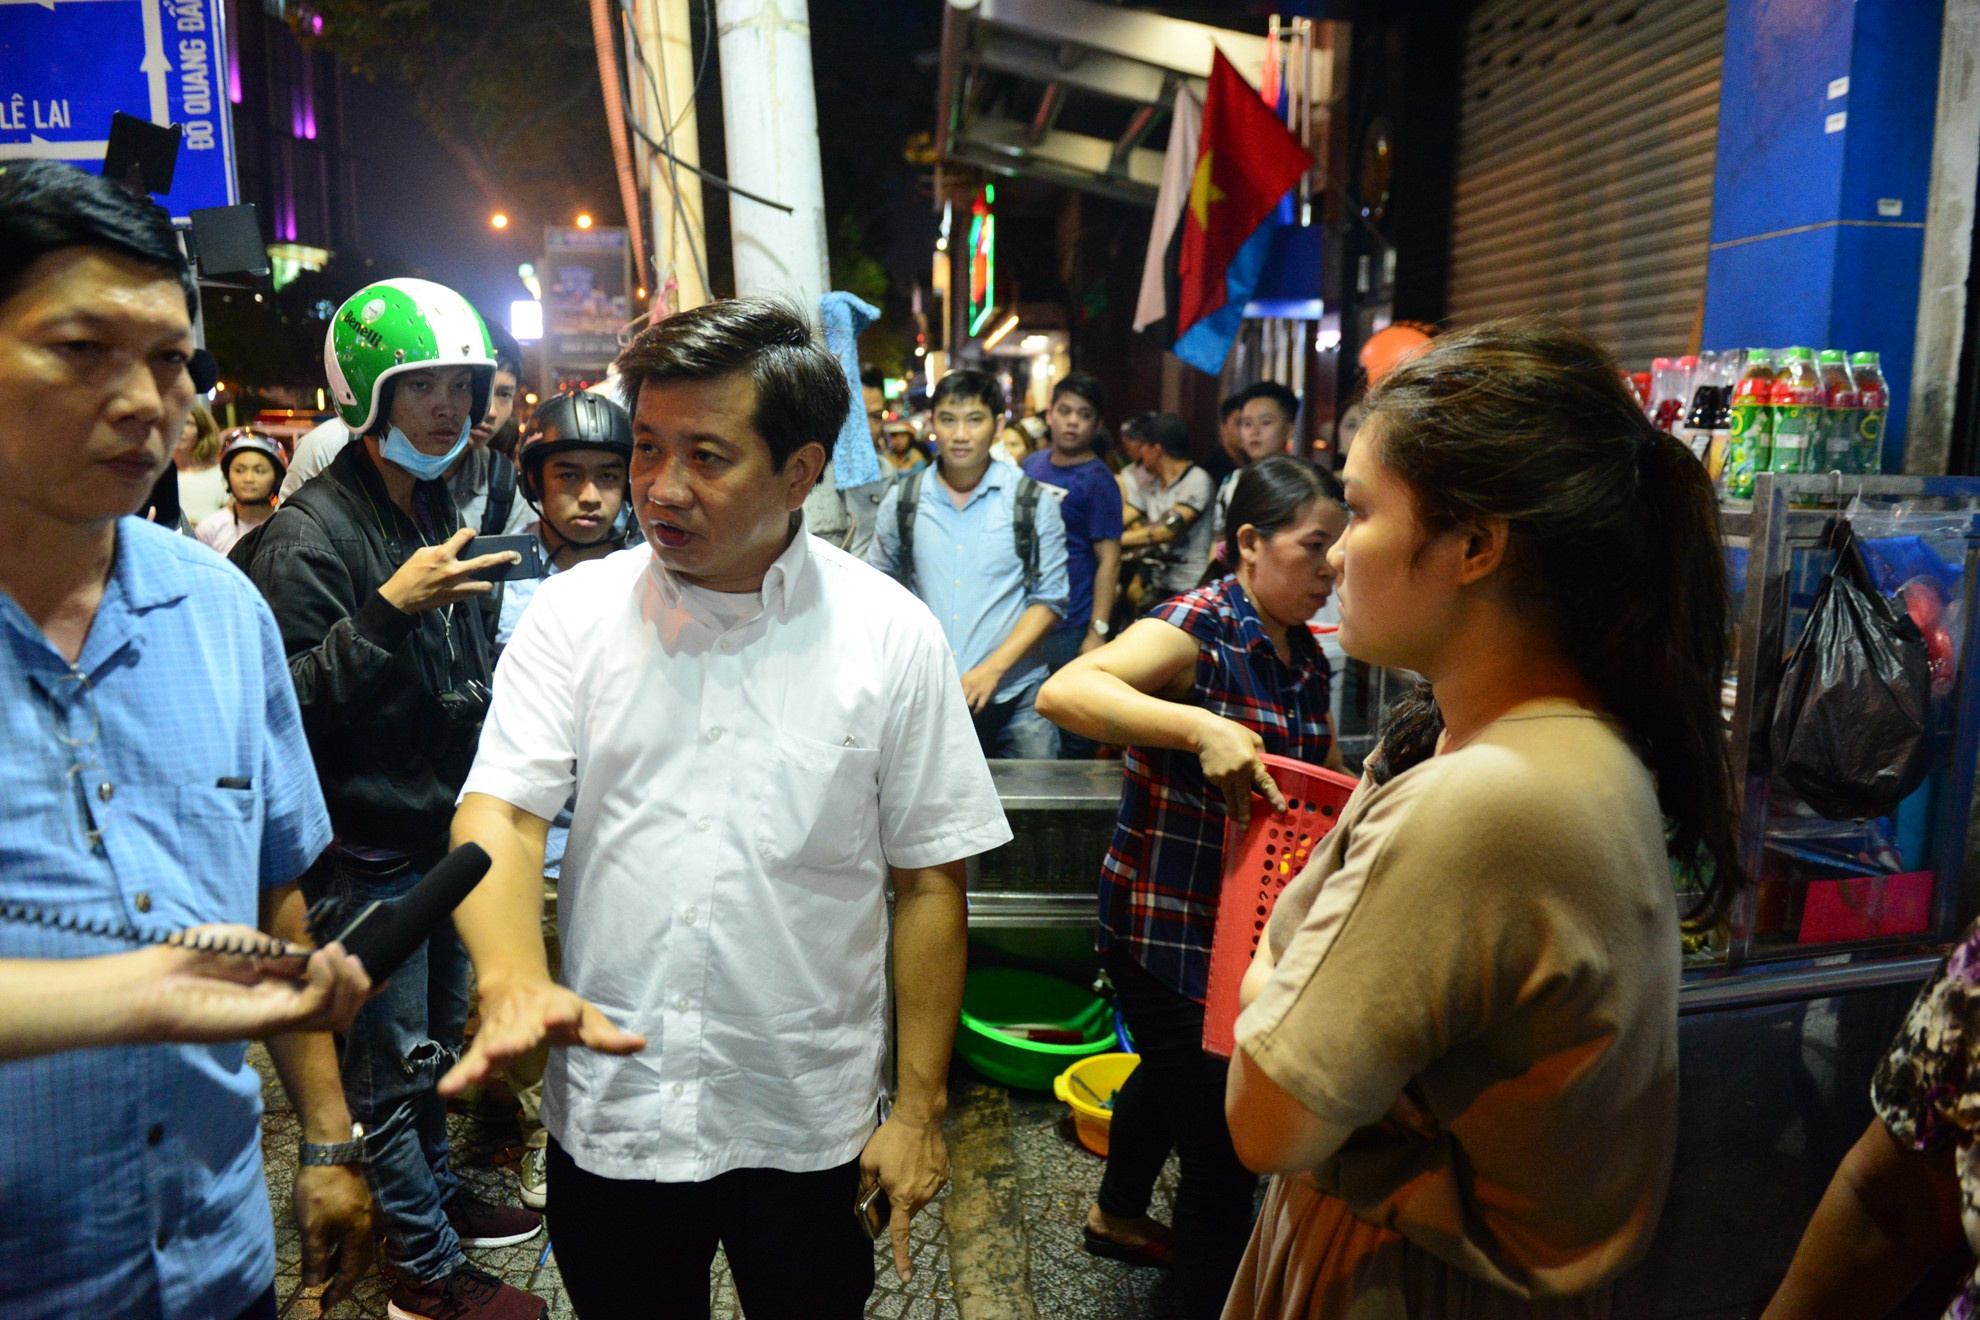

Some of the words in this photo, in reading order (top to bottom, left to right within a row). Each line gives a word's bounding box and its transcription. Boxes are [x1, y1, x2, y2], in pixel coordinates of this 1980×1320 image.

[179, 39, 211, 114] QUANG
[0, 92, 26, 129] LÊ
[33, 99, 71, 128] LAI
[344, 310, 383, 348] Benelli
